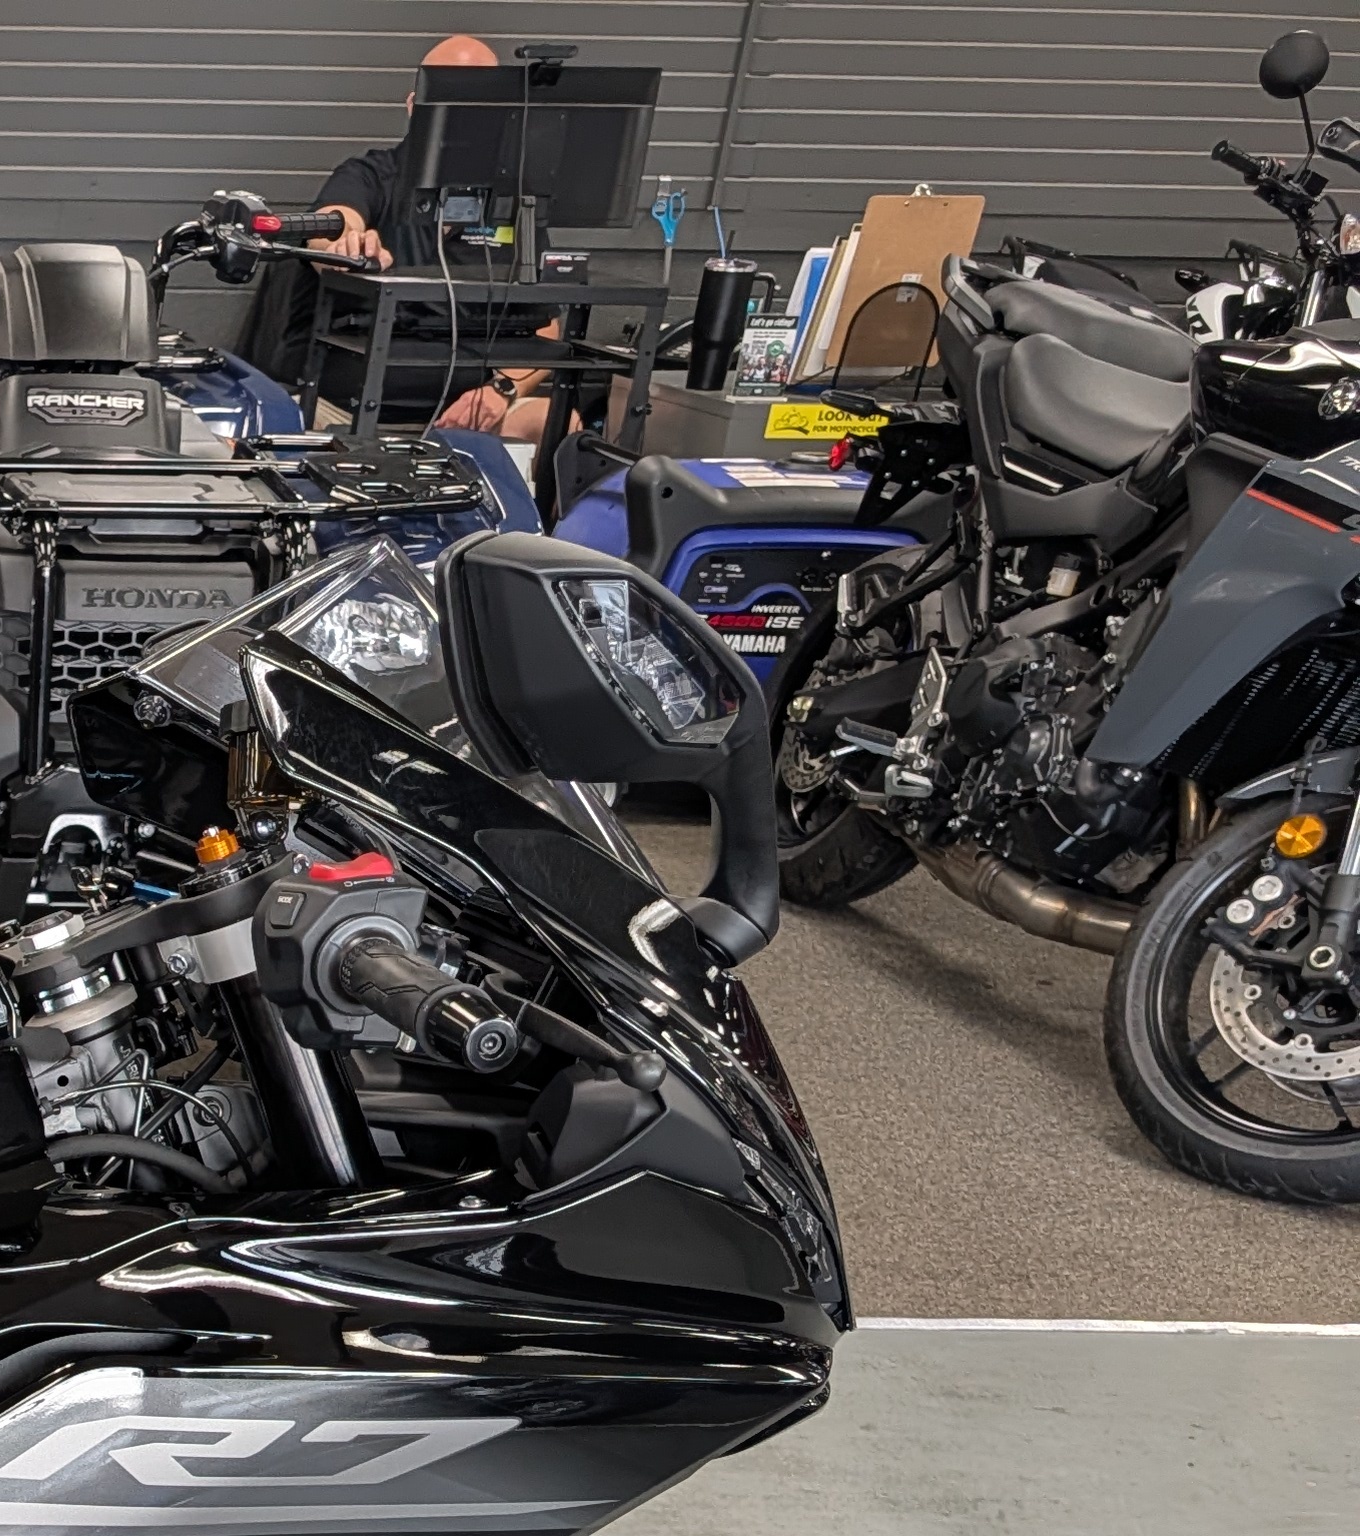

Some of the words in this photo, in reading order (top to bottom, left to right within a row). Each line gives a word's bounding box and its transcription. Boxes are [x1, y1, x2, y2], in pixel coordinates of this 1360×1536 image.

[26, 394, 145, 411] RANCHER
[812, 424, 829, 433] FOR
[81, 587, 235, 609] HONDA
[751, 604, 801, 615] INVERTER
[696, 614, 805, 630] 4500iSE
[722, 633, 787, 654] YAMAHA
